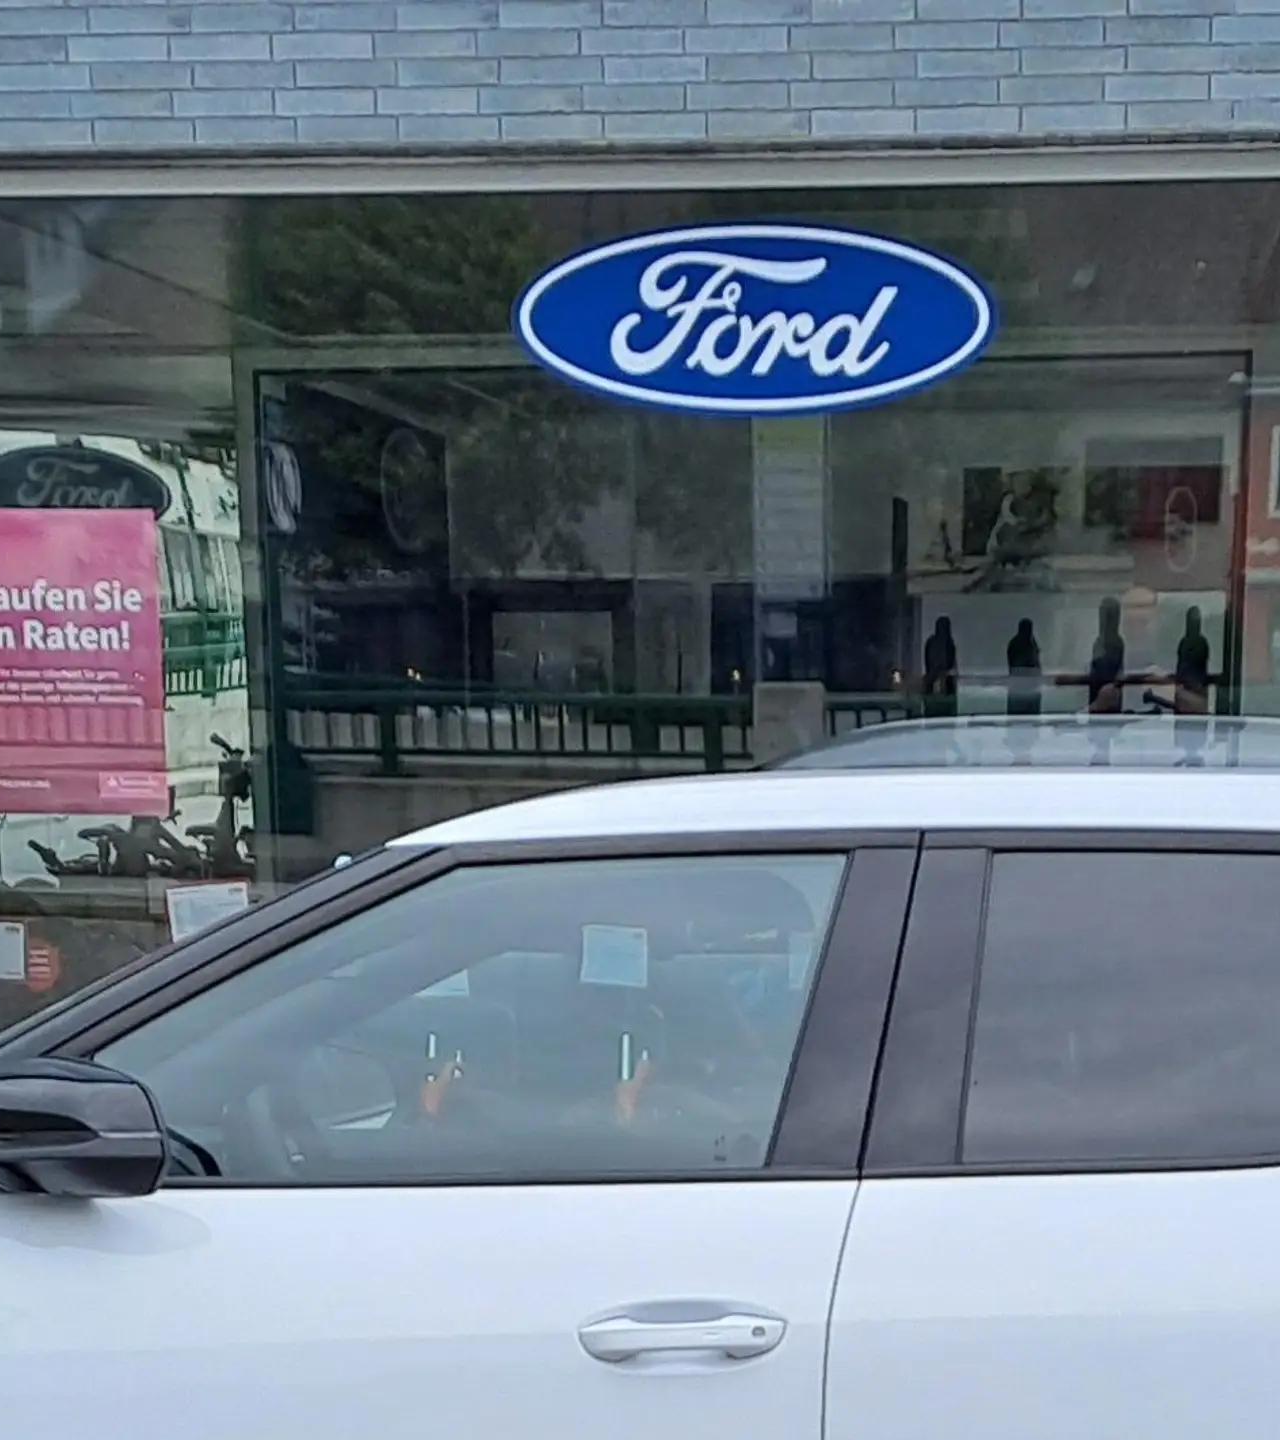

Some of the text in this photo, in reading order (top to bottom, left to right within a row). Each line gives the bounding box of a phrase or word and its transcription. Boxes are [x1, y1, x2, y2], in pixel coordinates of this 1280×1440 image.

[609, 249, 899, 377] Ford
[93, 579, 142, 612] Sie
[23, 618, 131, 651] Raten!
